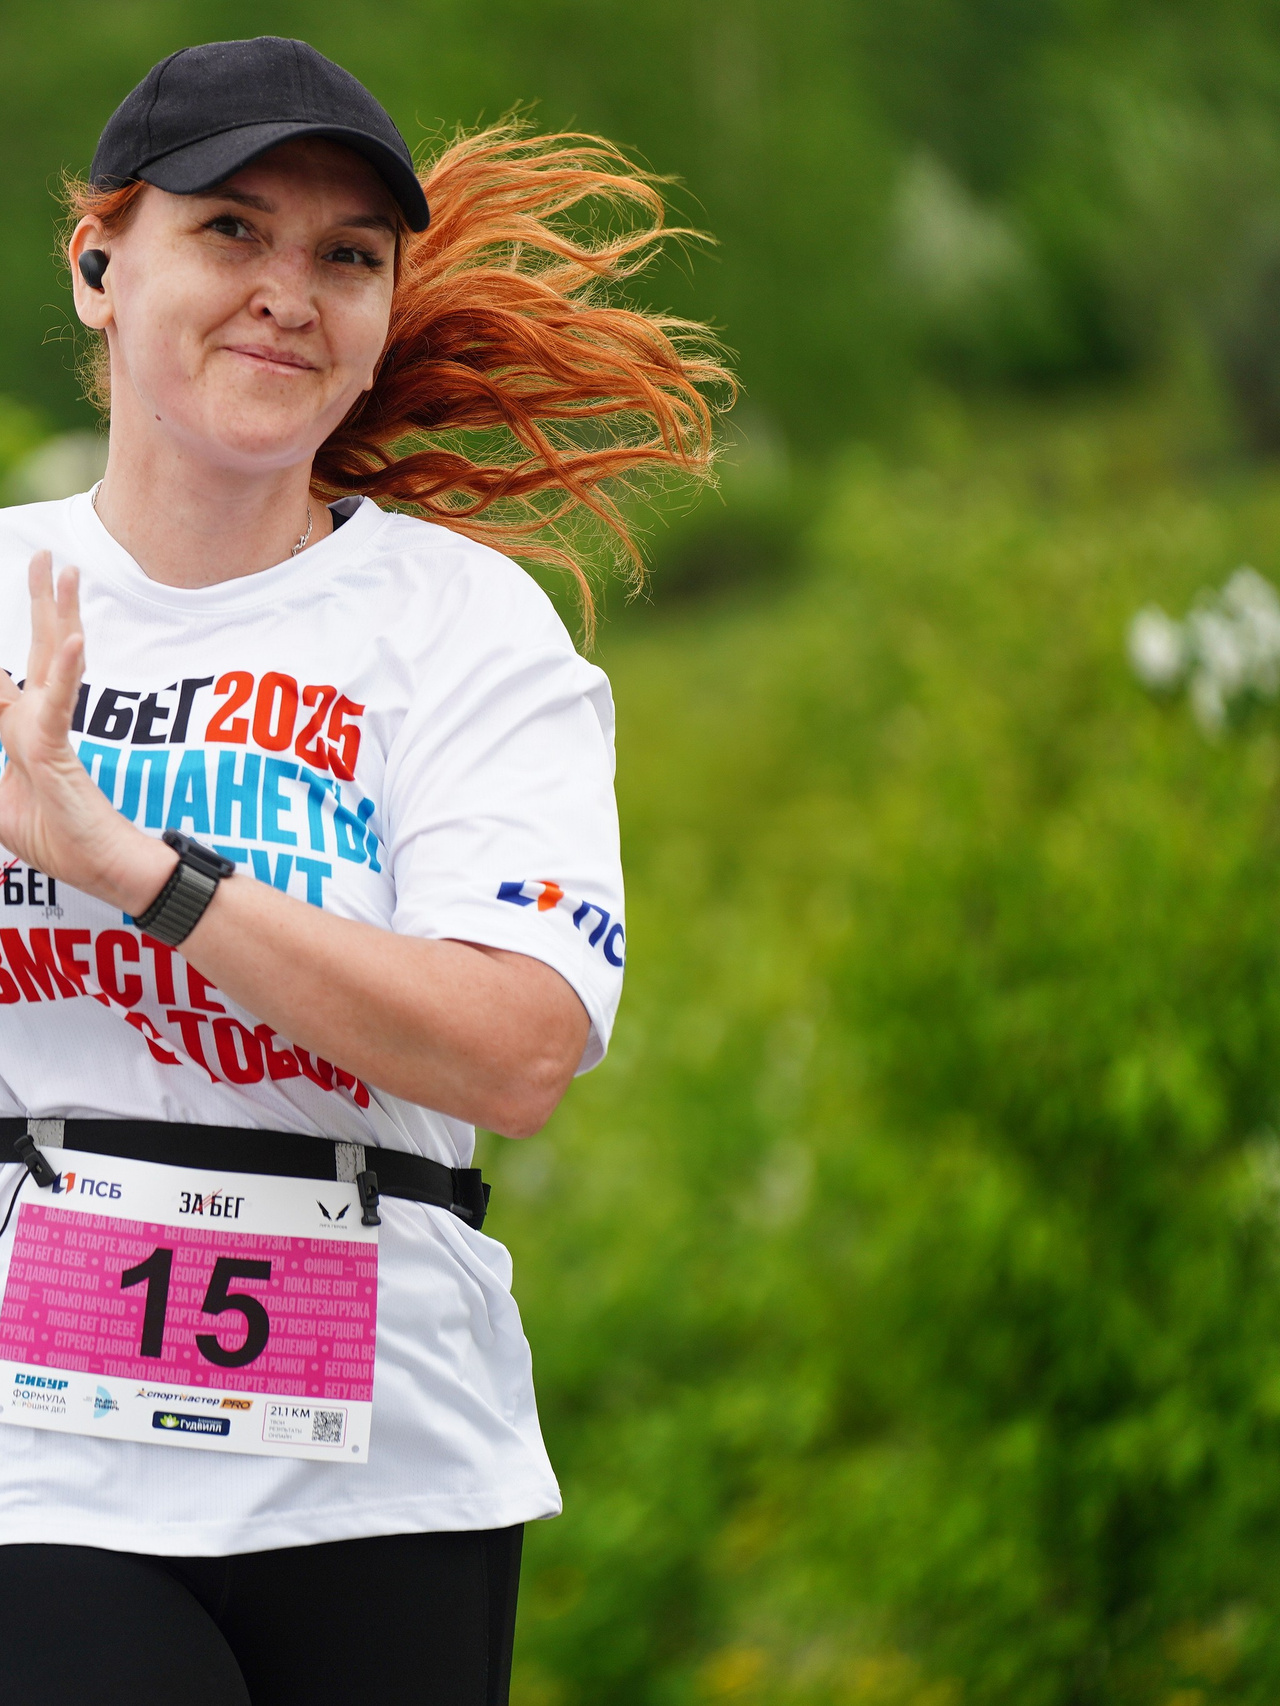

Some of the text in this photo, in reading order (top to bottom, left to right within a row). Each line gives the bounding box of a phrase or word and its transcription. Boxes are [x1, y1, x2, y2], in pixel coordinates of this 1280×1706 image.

[80, 1178, 122, 1200] ПСБ
[108, 1216, 144, 1235] РАМКИ
[34, 1244, 53, 1261] БЕГ
[53, 1247, 61, 1263] В
[61, 1249, 87, 1267] СЕБЕ
[283, 1275, 311, 1294] ПОКА
[312, 1277, 331, 1295] ВСЕ
[332, 1278, 357, 1298] СПЯТ
[63, 1229, 78, 1246] НА
[77, 1232, 116, 1252] СТАРТЕ
[176, 1246, 202, 1264] БЕГУ
[303, 1256, 343, 1276] ФИНИШ
[23, 1264, 59, 1285] ДАВНО
[59, 1270, 100, 1290] ОТСТАЛ
[296, 1295, 370, 1321] ПЕРЕЗАГРУЗКА
[40, 1287, 82, 1309] ТОЛЬКО
[82, 1294, 126, 1316] НАЧАЛО
[287, 1317, 316, 1336] ВСЕМ
[317, 1318, 363, 1342] СЕРДЦЕМ
[120, 1247, 272, 1368] 15
[46, 1309, 79, 1329] ЛЮБИ
[78, 1314, 99, 1332] БЕГ
[99, 1317, 108, 1333] В
[108, 1318, 136, 1337] СЕБЕ
[333, 1341, 359, 1360] ПОКА
[53, 1330, 95, 1351] СТРЕСС
[95, 1337, 133, 1358] ДАВНО
[268, 1355, 305, 1375] РАМКИ
[324, 1359, 369, 1381] БЕГОВАЯ
[13, 1389, 67, 1405] ФОРМУЛА
[15, 1373, 69, 1391] СИБУР
[45, 1350, 89, 1371] ФИНИШ
[102, 1358, 146, 1379] ТОЛЬКО
[146, 1364, 191, 1384] НАЧАЛО
[208, 1371, 223, 1388] НА
[224, 1372, 265, 1392] СТАРТЕ
[266, 1376, 306, 1395] ЖИЗНИ
[324, 1381, 348, 1399] БЕГУ
[222, 1399, 251, 1410] PRO
[271, 1406, 288, 1416] 21.1
